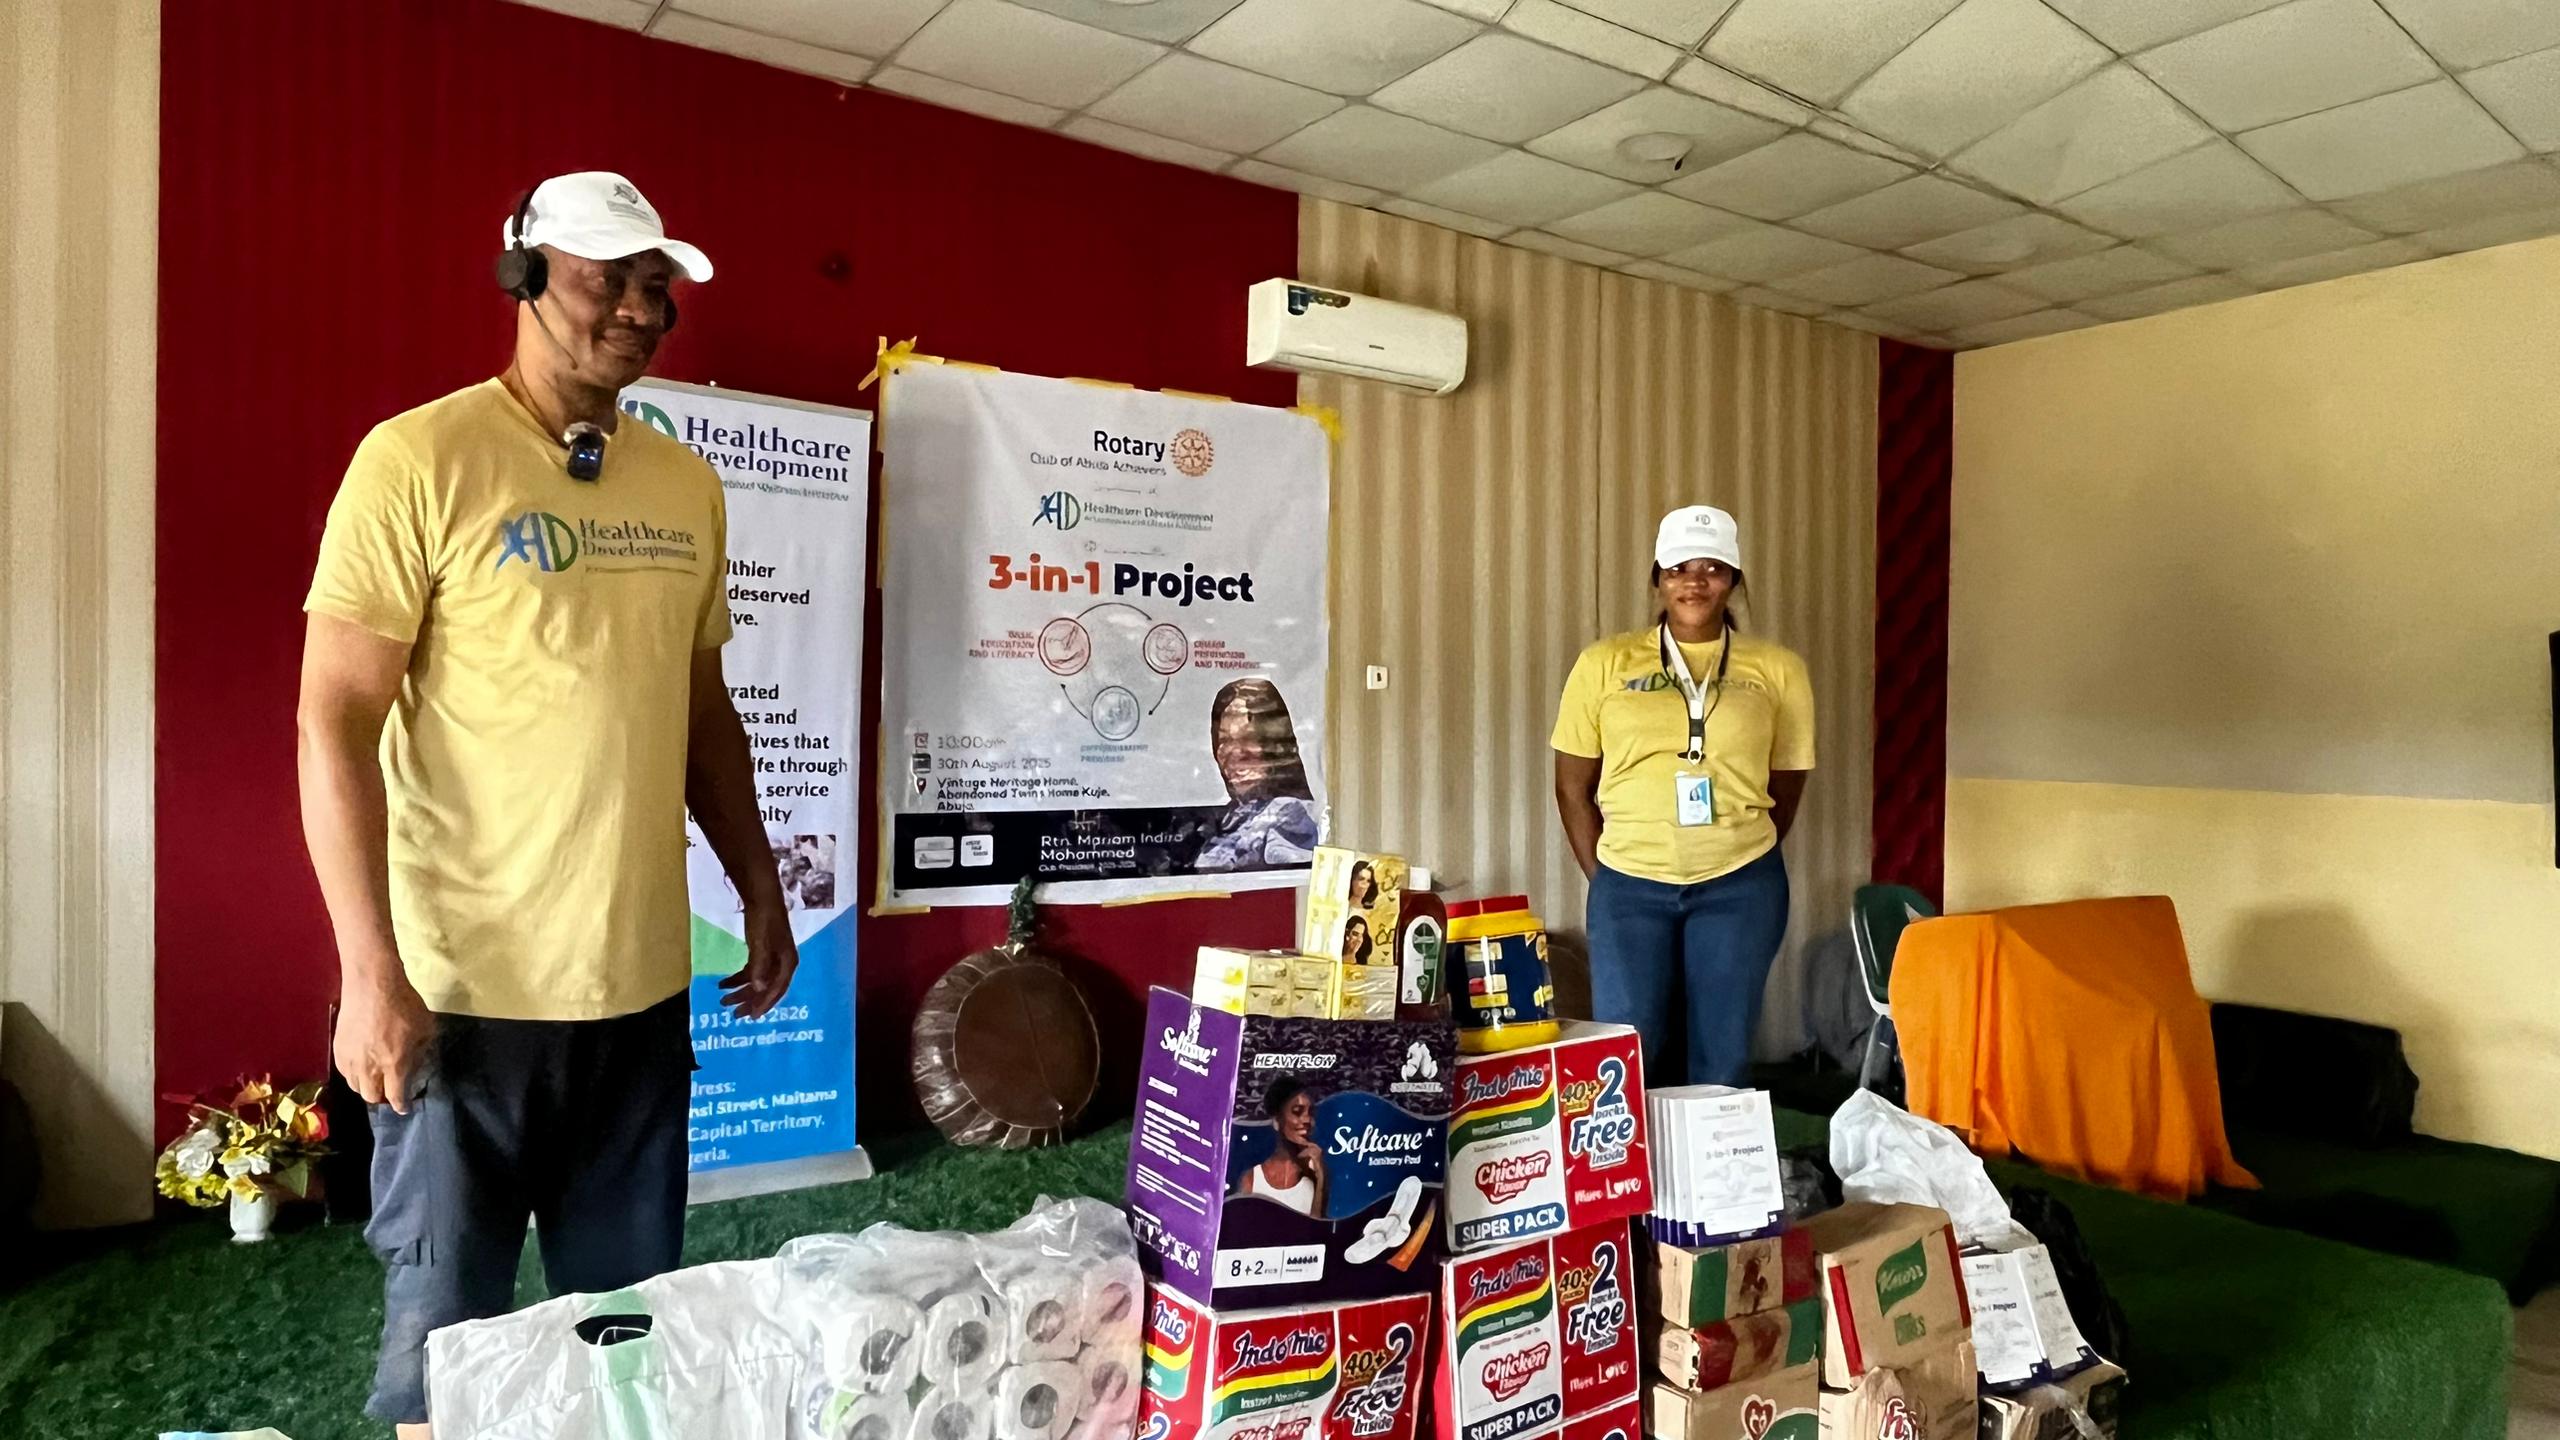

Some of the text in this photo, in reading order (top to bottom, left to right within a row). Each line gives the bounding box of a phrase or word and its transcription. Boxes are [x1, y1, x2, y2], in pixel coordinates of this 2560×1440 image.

[686, 416, 851, 462] Healthcare
[1094, 430, 1166, 462] Rotary
[1060, 456, 1073, 466] of
[578, 518, 696, 546] Healthcare
[989, 553, 1255, 607] 3-in-1 Project
[728, 584, 810, 605] deserved
[728, 684, 779, 699] rated
[740, 709, 797, 725] ss and
[794, 733, 830, 750] that
[780, 758, 848, 776] through
[937, 758, 968, 770] 30th
[971, 757, 1018, 773] August
[766, 782, 829, 797] service
[937, 777, 987, 792] Vintage
[990, 777, 1041, 791] Heritage
[937, 786, 1008, 800] Abandoned
[1040, 846, 1136, 861] Mohammed
[1077, 834, 1136, 849] Mariam
[699, 1011, 732, 1029] 913
[769, 1005, 809, 1024] 2826
[1255, 1053, 1336, 1068] HEAVY FLOW
[1461, 1065, 1546, 1104] Indomie
[1560, 1057, 1625, 1109] 40+ 2
[772, 1089, 838, 1108] Maitama
[689, 1114, 825, 1142] Capital Territory.
[1571, 1117, 1633, 1152] Free
[1328, 1124, 1422, 1163] Softcare
[1478, 1156, 1549, 1184] Chicken
[1462, 1207, 1560, 1242] SUPER PACK
[1469, 1256, 1545, 1300] Indomie
[1559, 1242, 1617, 1295] 40+ 2
[1154, 1301, 1186, 1344] mie
[1568, 1301, 1623, 1342] Free
[1233, 1327, 1329, 1374] Indomie
[1344, 1325, 1413, 1379] 40+ 2
[1483, 1350, 1548, 1384] Chicken
[1333, 1385, 1404, 1418] Free
[1470, 1402, 1556, 1440] SUPER PACK
